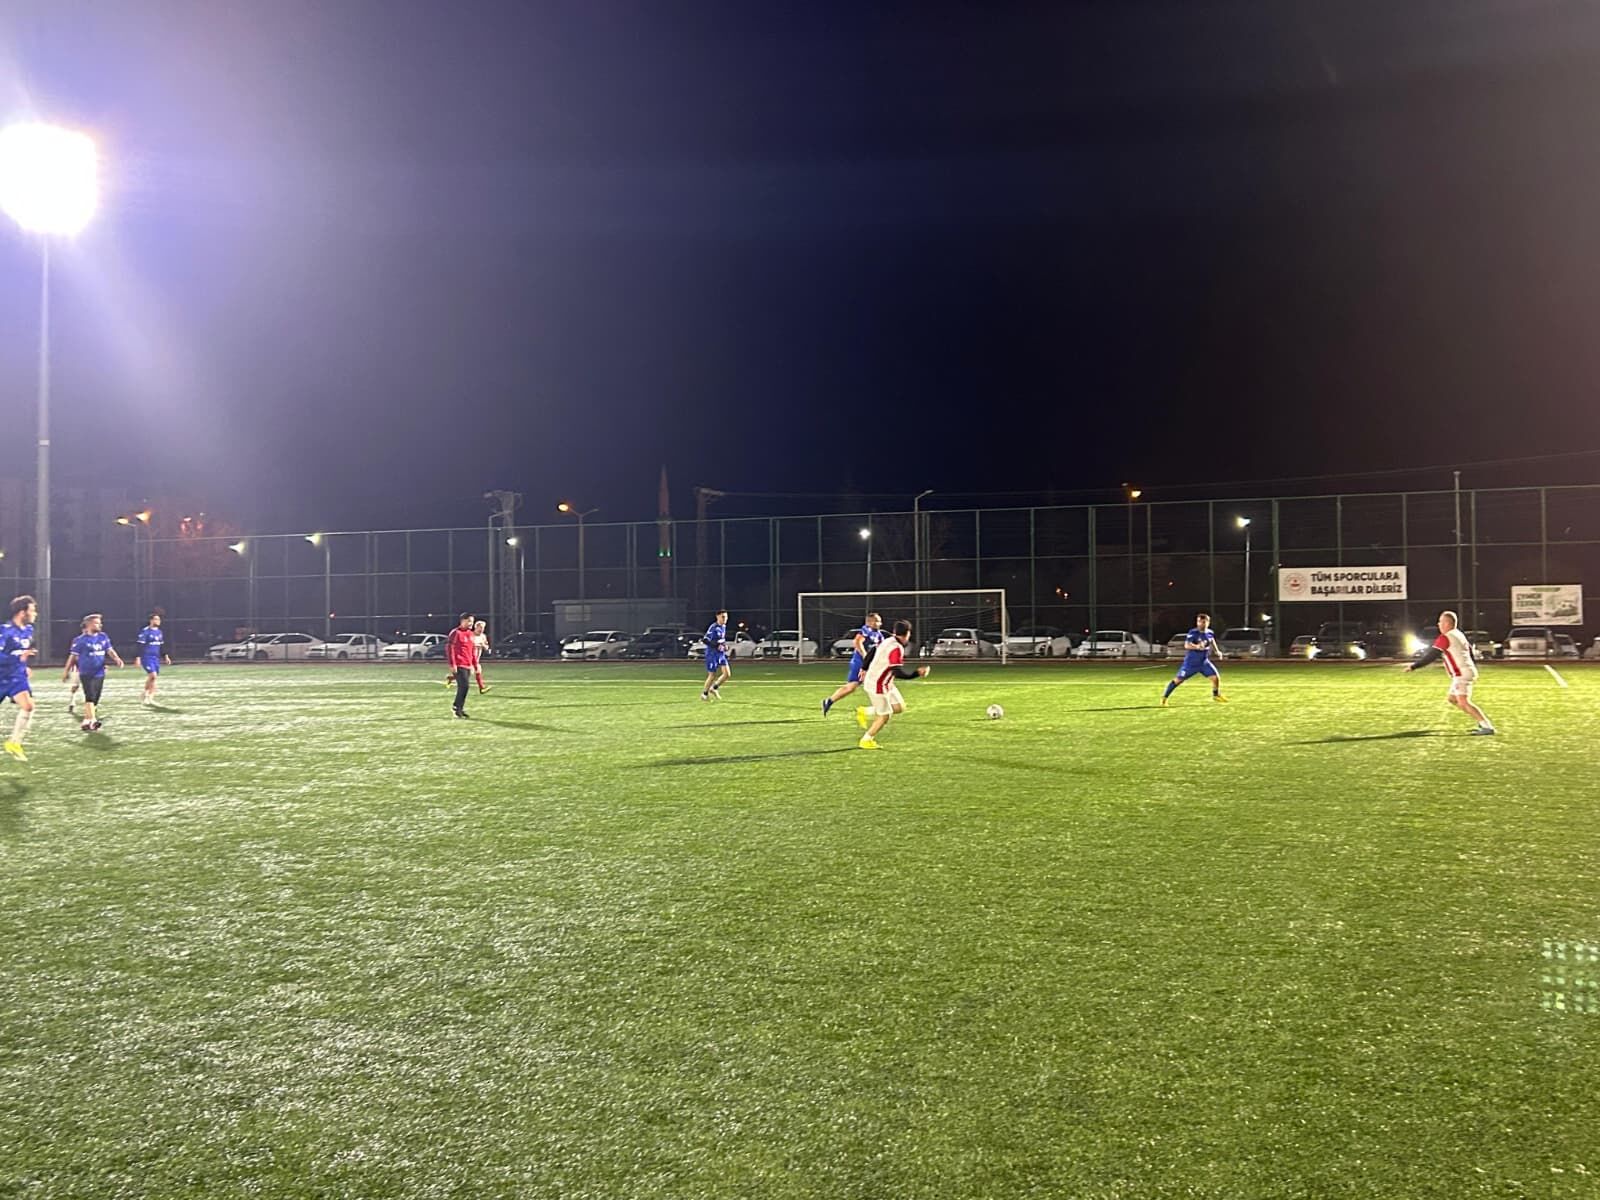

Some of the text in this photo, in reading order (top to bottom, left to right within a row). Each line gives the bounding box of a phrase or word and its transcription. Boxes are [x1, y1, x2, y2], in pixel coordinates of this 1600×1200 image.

[1310, 571, 1400, 582] TÜM SPORCULARA
[1311, 582, 1403, 597] BAŞARILAR DİLERİZ
